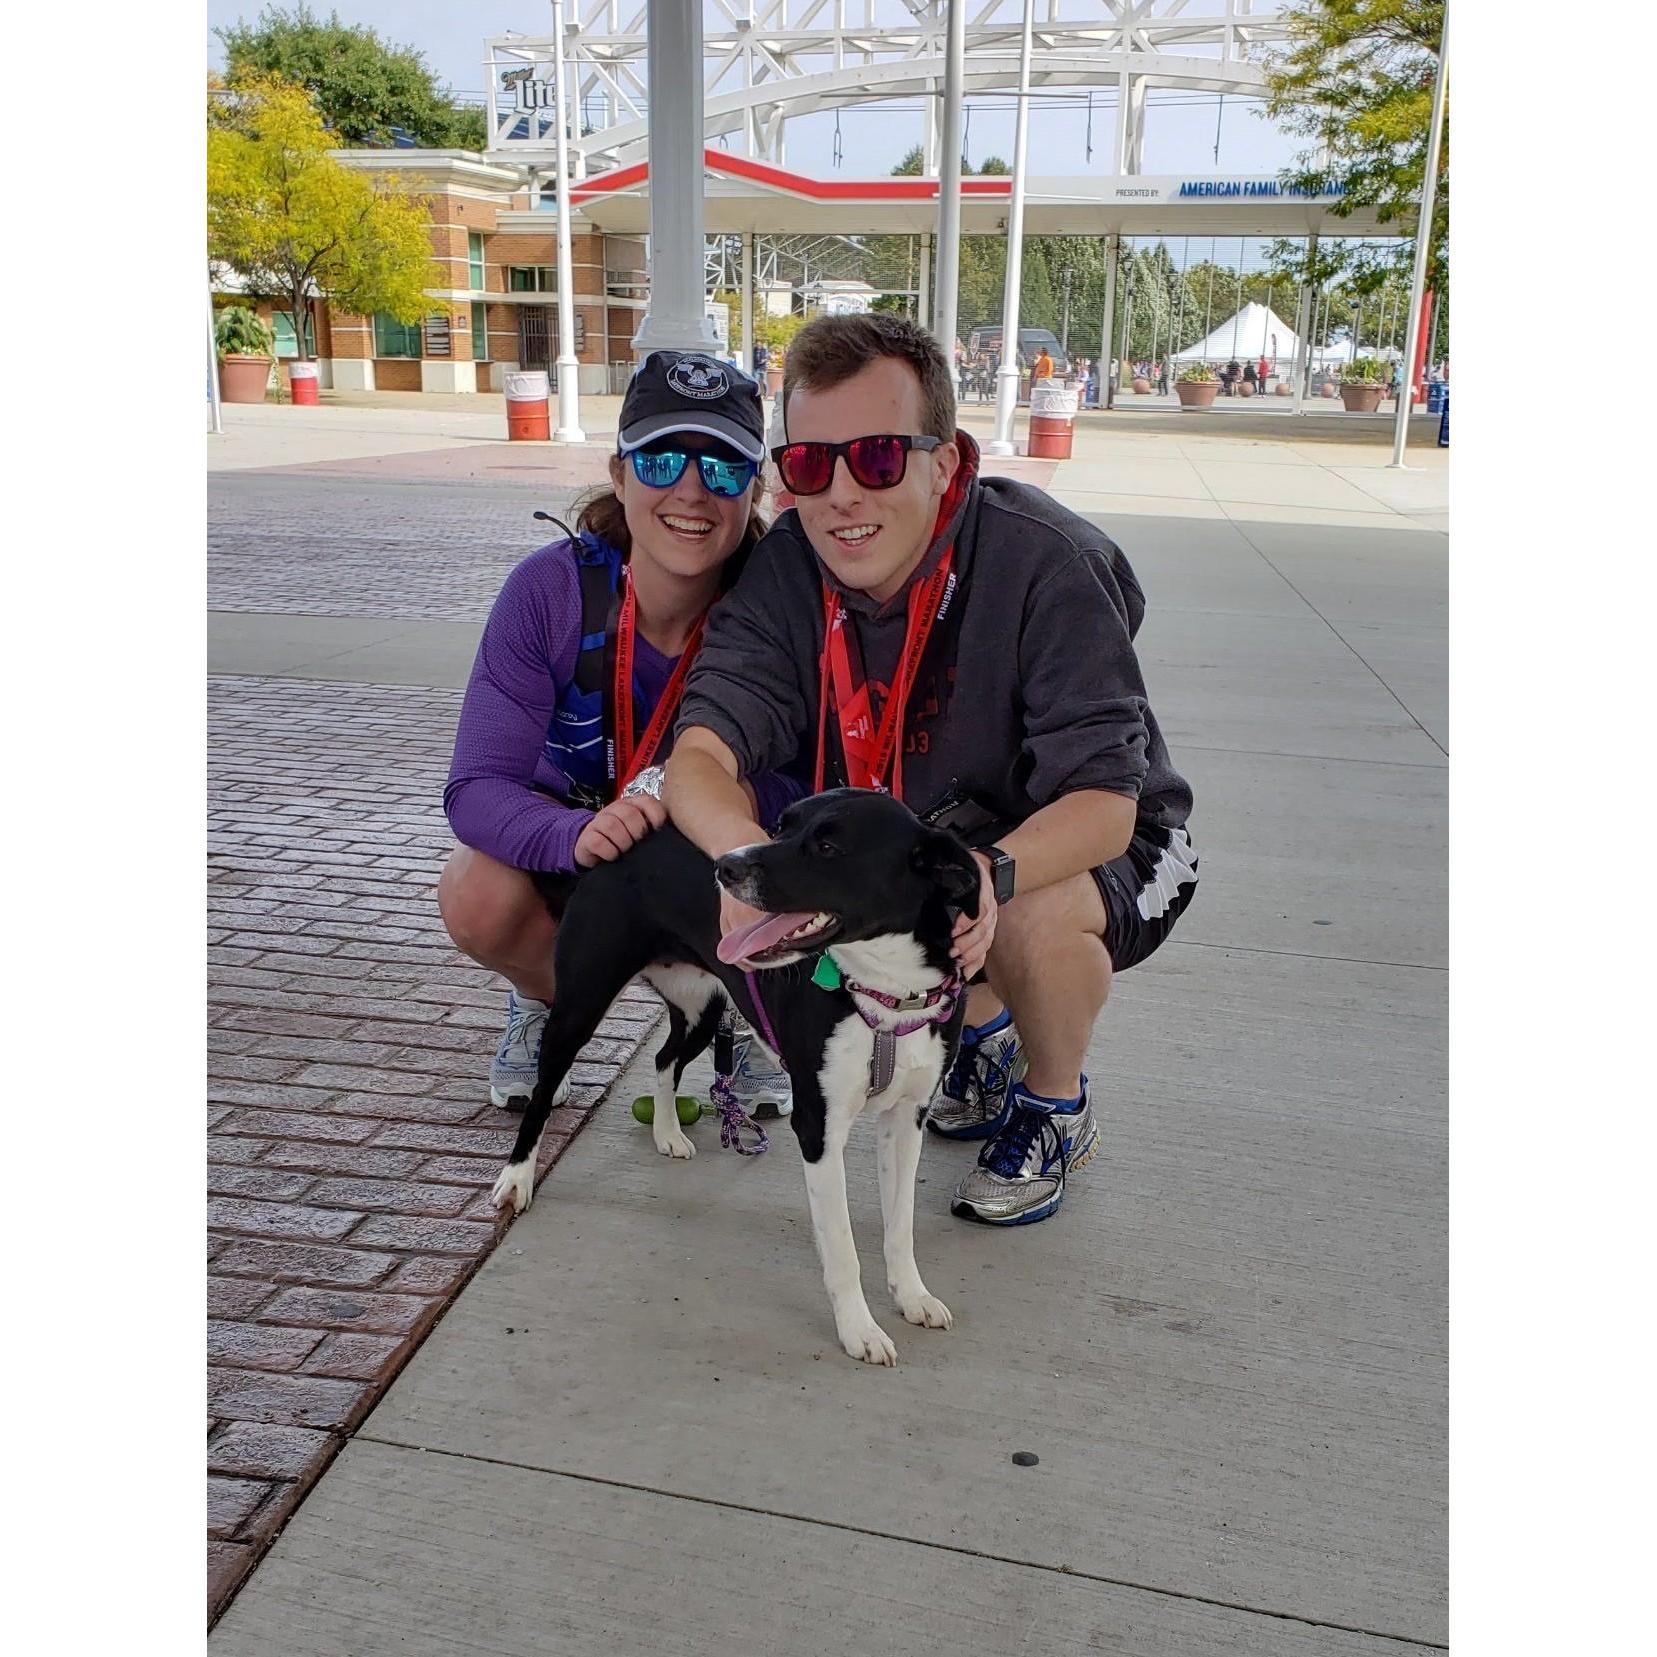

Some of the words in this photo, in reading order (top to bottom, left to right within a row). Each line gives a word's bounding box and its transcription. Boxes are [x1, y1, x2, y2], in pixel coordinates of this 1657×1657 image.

[1115, 189, 1150, 198] PRESENTED
[1179, 181, 1241, 197] AMERICAN
[1243, 181, 1286, 197] FAMILY
[936, 573, 957, 621] FINISHER
[606, 738, 615, 779] FINISHER
